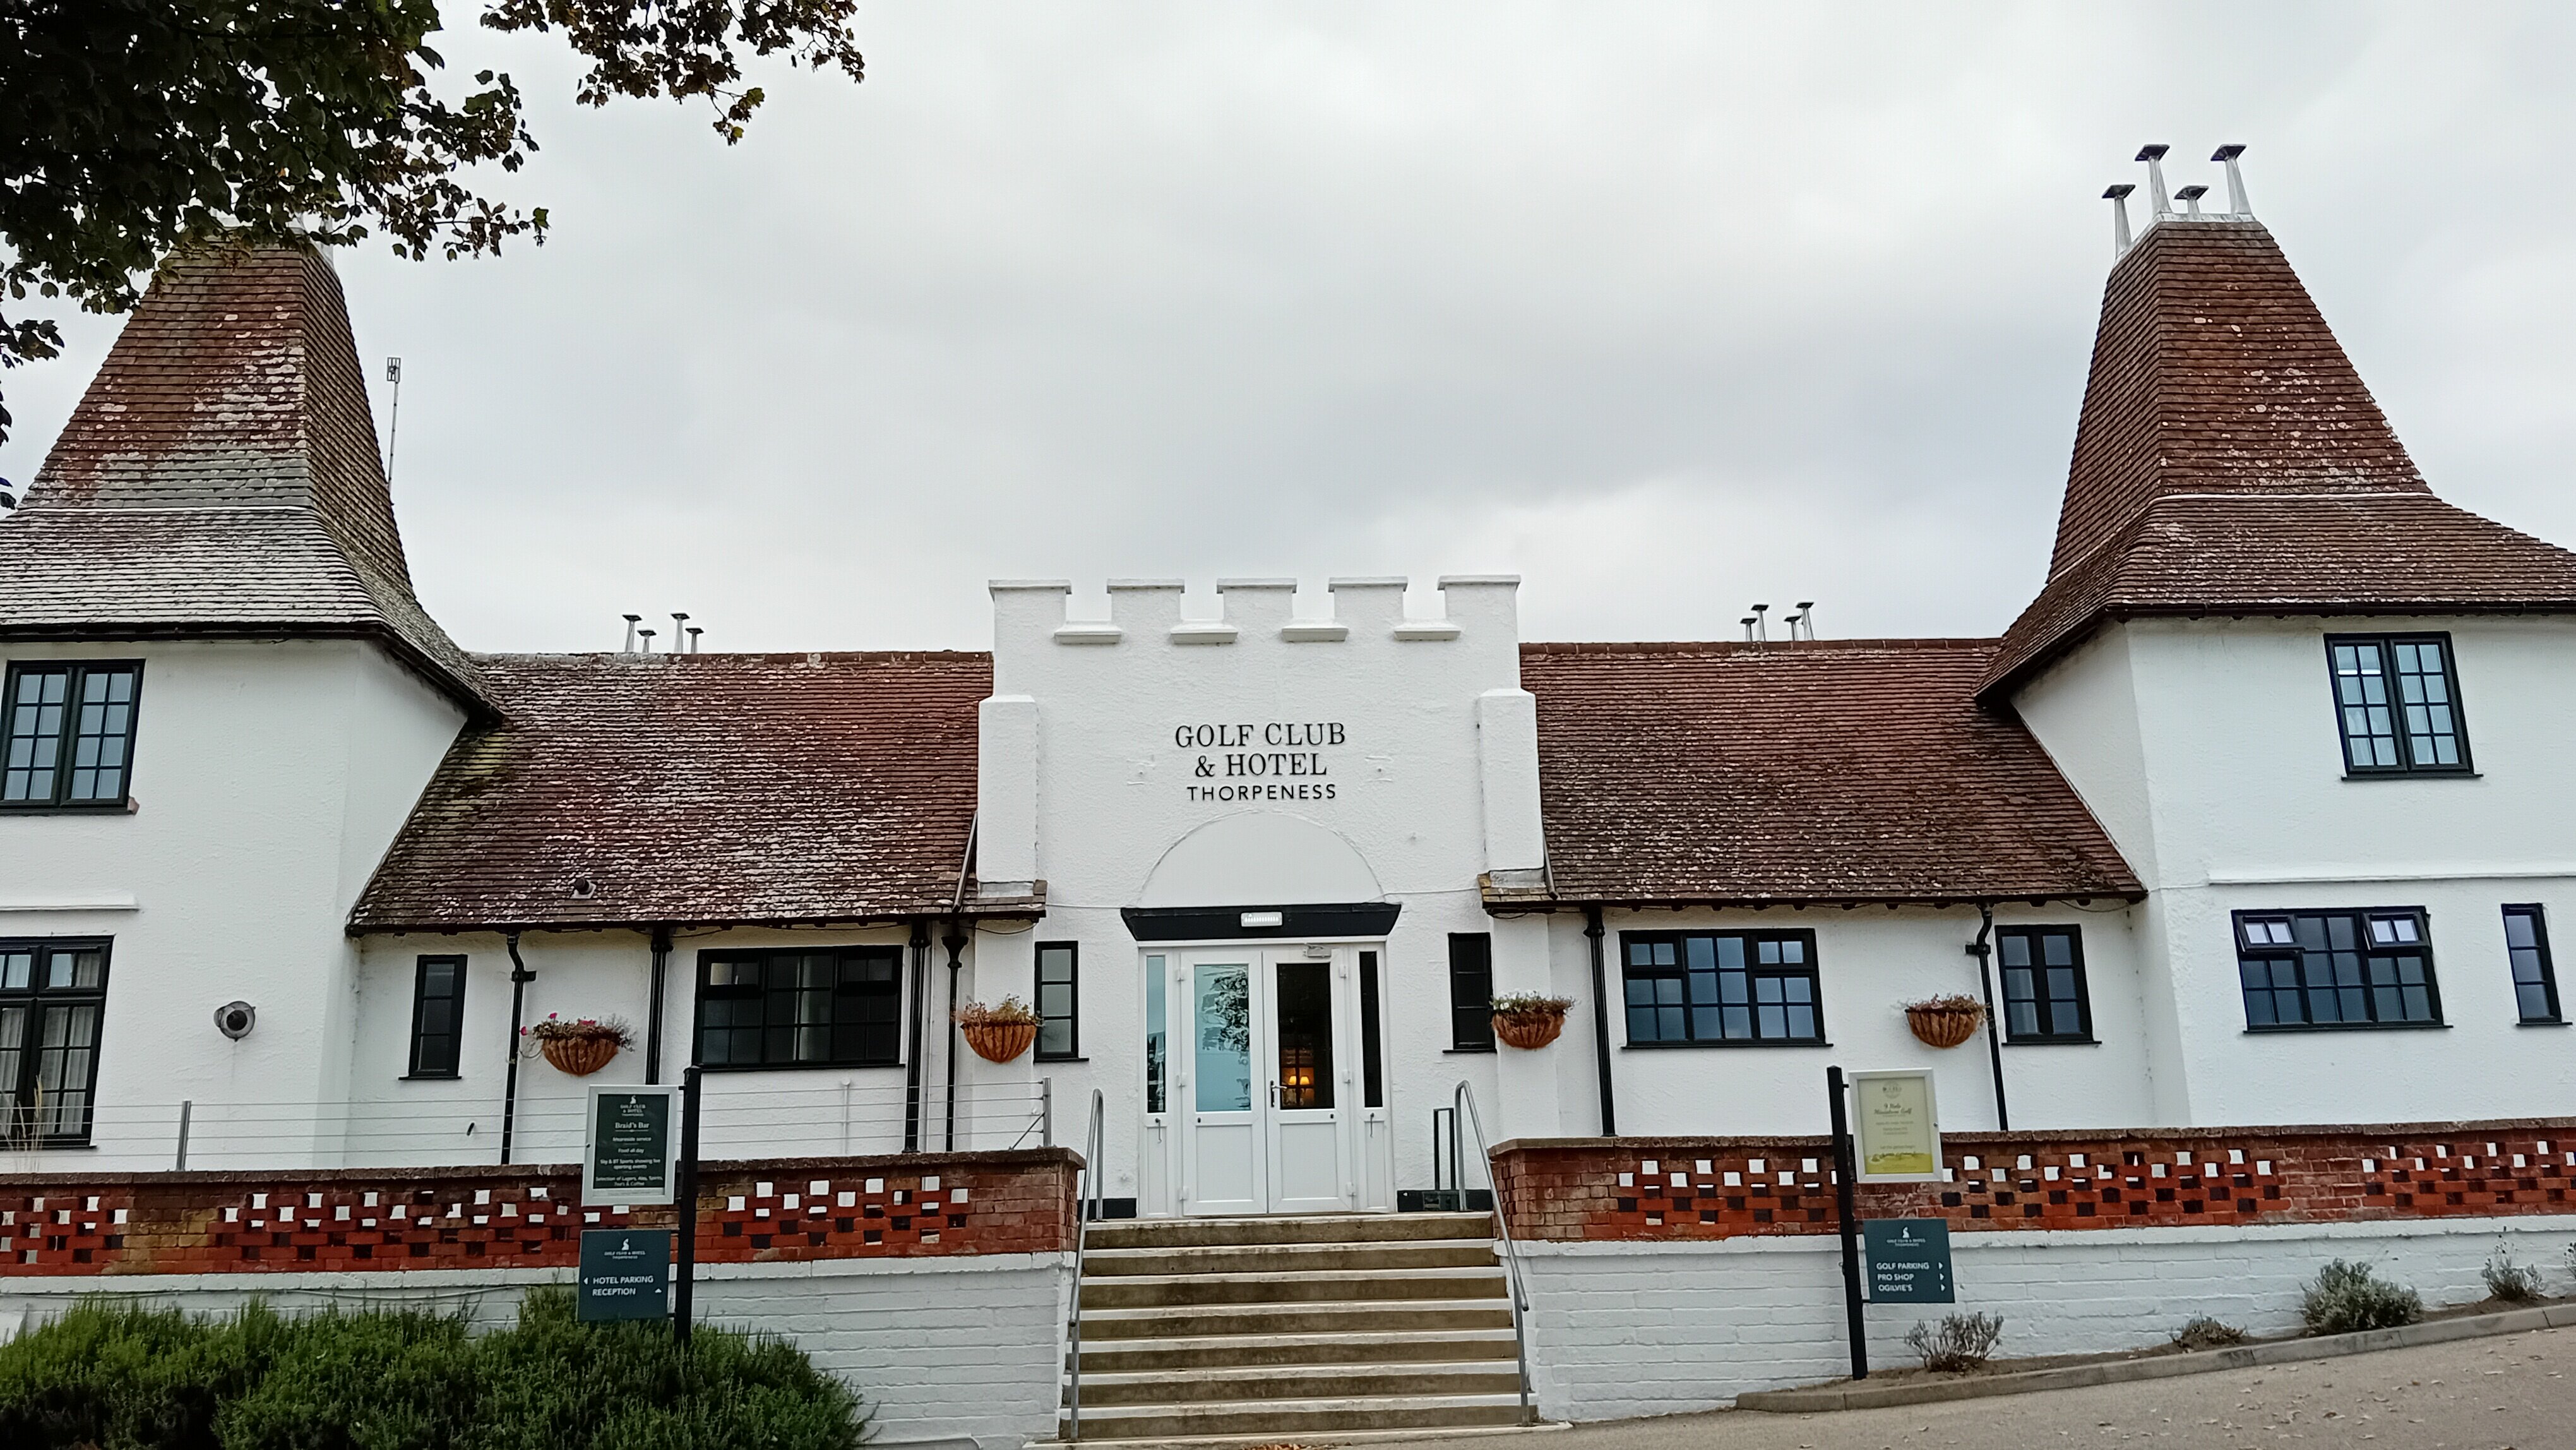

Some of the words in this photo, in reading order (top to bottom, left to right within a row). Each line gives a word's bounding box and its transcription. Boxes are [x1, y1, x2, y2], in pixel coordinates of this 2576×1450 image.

[1176, 724, 1253, 748] GOLF
[1265, 722, 1345, 745] CLUB
[1195, 756, 1215, 777] &
[1226, 753, 1327, 776] HOTEL
[1187, 784, 1335, 800] THORPENESS
[592, 1288, 636, 1296] RECEPTION
